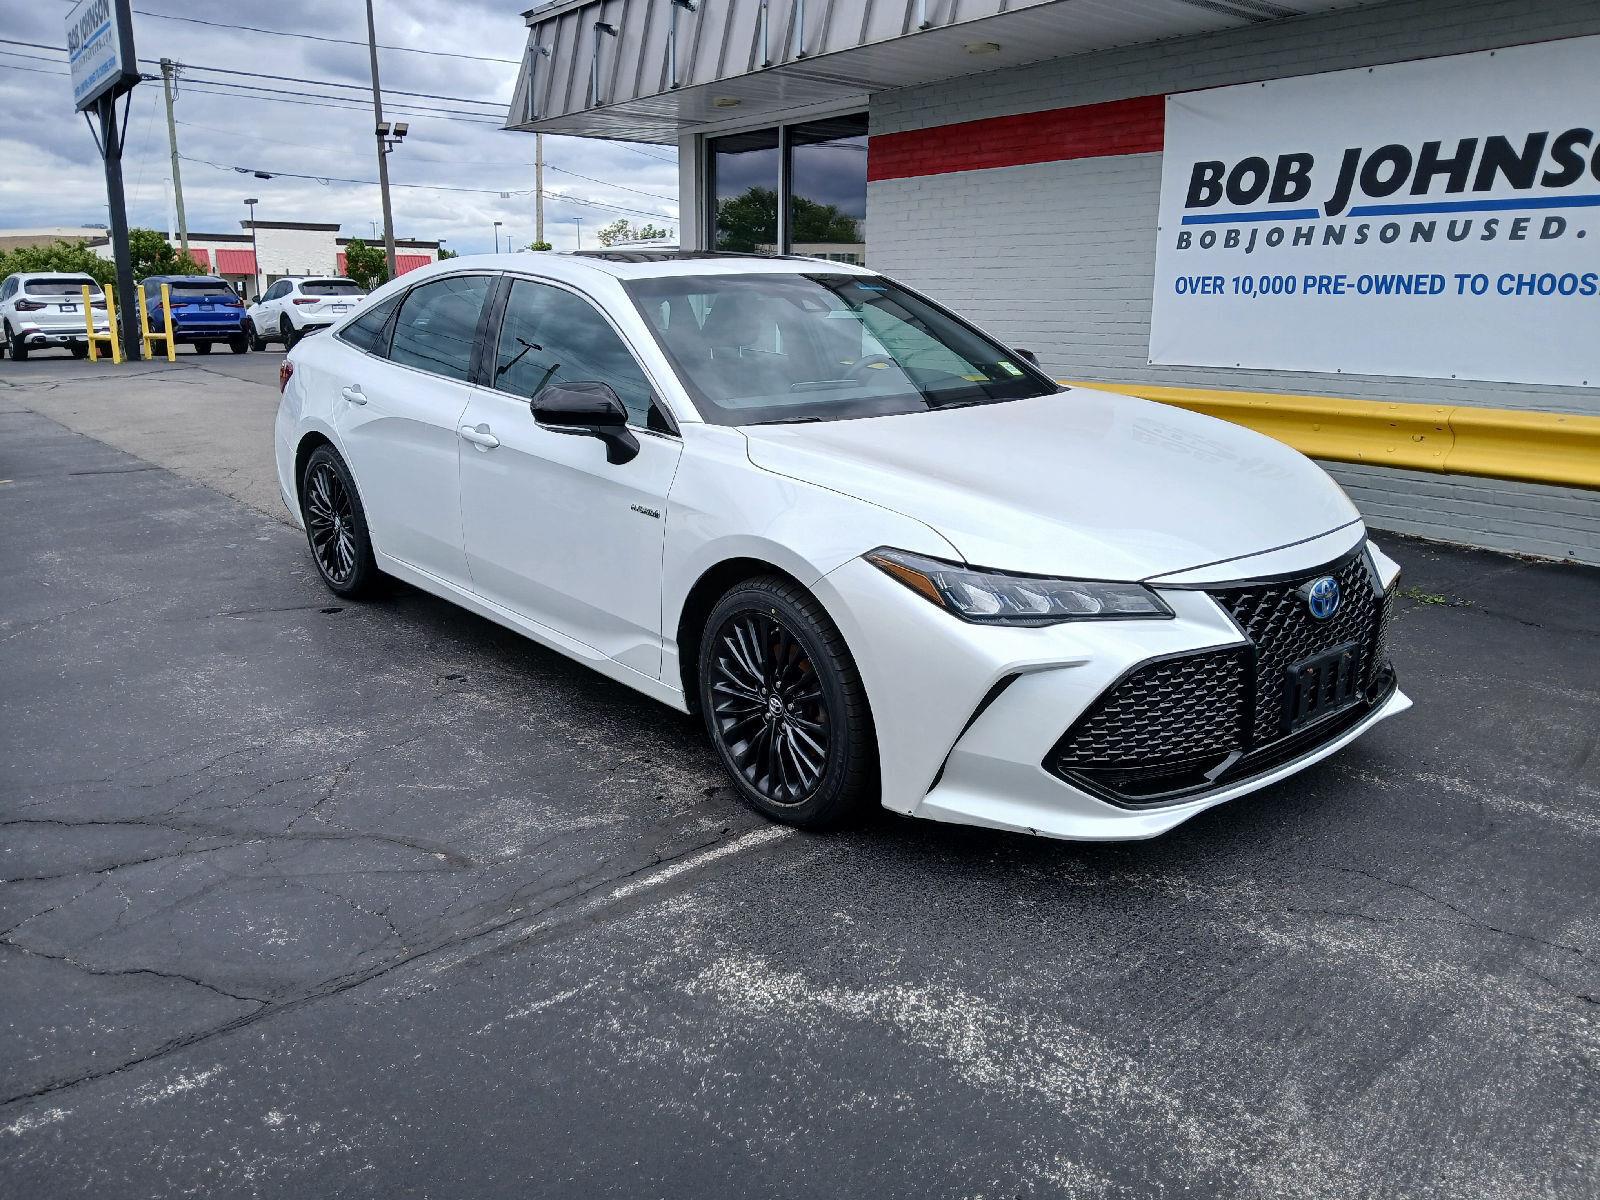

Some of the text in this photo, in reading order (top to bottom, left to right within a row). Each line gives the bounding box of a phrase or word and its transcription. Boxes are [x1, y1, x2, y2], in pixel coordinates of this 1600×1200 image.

[68, 24, 80, 56] BOB
[1185, 152, 1315, 208] BOB
[1174, 272, 1600, 299] OVER 10,000 PRE-OWNED TO CHOOS
